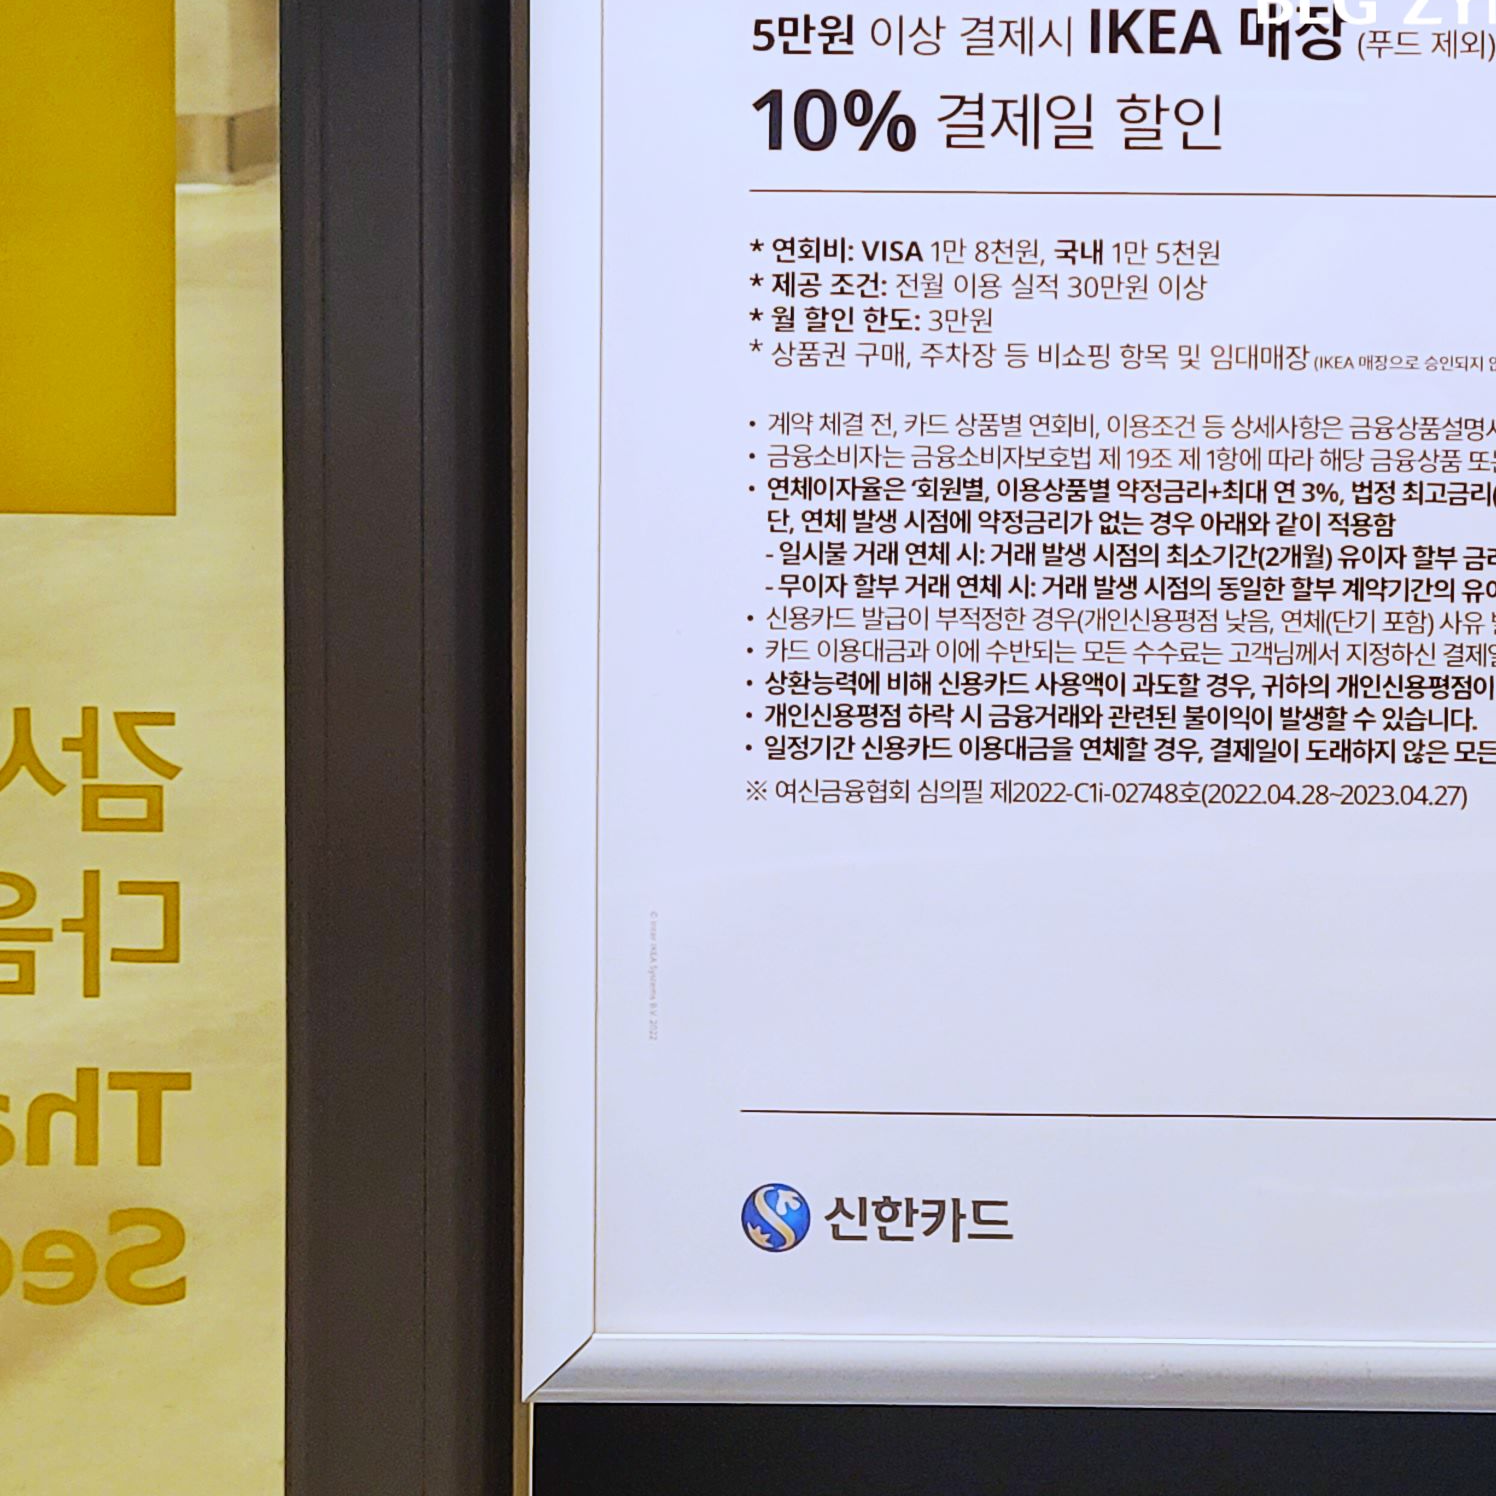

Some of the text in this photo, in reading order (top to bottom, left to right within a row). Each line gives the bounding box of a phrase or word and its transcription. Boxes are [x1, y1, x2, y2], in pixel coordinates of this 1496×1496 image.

[752, 13, 855, 56] 5만원
[870, 14, 947, 57] 이상
[959, 15, 1072, 58] 결제시
[1089, 7, 1223, 56] IKEA
[1357, 29, 1423, 62] (푸드
[1430, 28, 1496, 63] 제외)
[751, 88, 1223, 153] 10% 결제일 할인
[771, 235, 1220, 268] 연회비: VISA 1만 8천원, 국내 1만 5천원
[771, 270, 1209, 302] 제공 조건: 전월 이용 실적 30만원 이상
[770, 305, 993, 334] 월 할인 한도: 3만원
[770, 340, 846, 368] 상품권
[854, 340, 911, 371] 구매,
[919, 341, 998, 369] 주차장
[1003, 342, 1030, 369] 등
[1038, 342, 1110, 370] 비쇼핑
[1119, 342, 1169, 371] 항목
[1178, 343, 1201, 371] 및
[768, 410, 815, 437] 계약
[818, 410, 864, 437] 체결
[870, 411, 898, 439] 전,
[903, 411, 950, 438] 카드
[954, 411, 1023, 438] 상품별
[1028, 412, 1100, 441] 연회비,
[1106, 413, 1196, 440] 이용조건
[1201, 414, 1226, 440] 등
[1230, 414, 1345, 441] 상세사항은
[767, 475, 908, 503] 연체이자율은
[996, 476, 1111, 504] 이용상품별
[1116, 477, 1268, 506] 약정금리+최대
[1273, 478, 1297, 505] 연
[1300, 481, 1345, 507] 3%,
[1351, 479, 1396, 506] 법정
[767, 507, 1398, 538] 단, 연체 발생 시점에 약정금리가 없는 경우 아래와 같이 적용함
[764, 669, 881, 697] 상환능력에
[887, 669, 932, 697] 비해
[937, 669, 1031, 697] 신용카드
[1034, 670, 1126, 699] 사용액이
[1131, 671, 1202, 699] 과도할
[1205, 672, 1256, 701] 경우,
[1260, 672, 1330, 700] 귀하의
[1335, 672, 1495, 702] 개인신용평점이
[763, 701, 1479, 734] 개인신용평점 하락 시 금융거래와 관련된 불이익이 발생할 수 있습니다.
[775, 777, 910, 805] 여신금융협회
[916, 778, 984, 806] 심의필
[823, 1195, 1014, 1244] 신한카드
